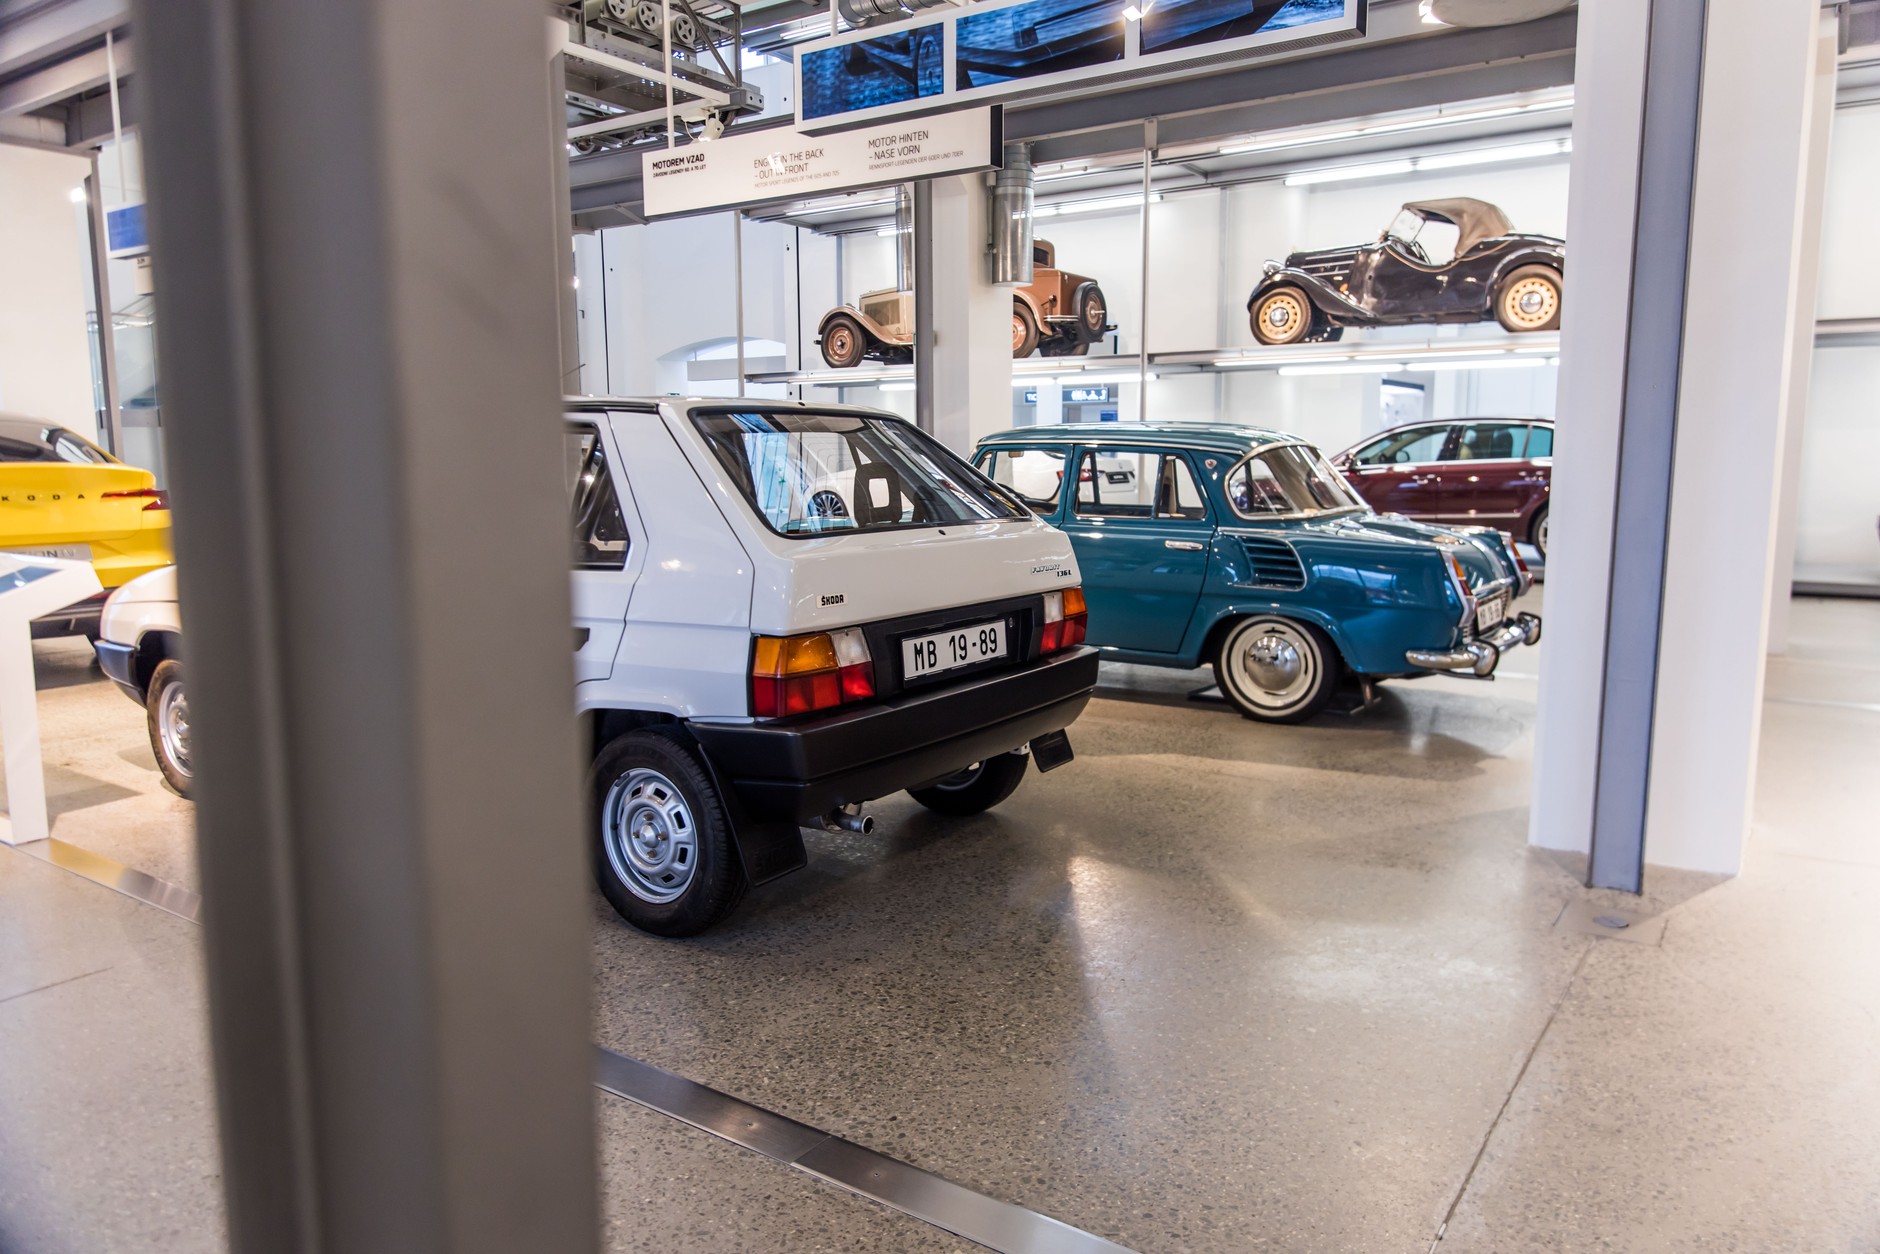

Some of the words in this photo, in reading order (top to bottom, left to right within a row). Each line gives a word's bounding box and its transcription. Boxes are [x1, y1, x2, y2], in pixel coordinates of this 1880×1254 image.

[868, 135, 897, 149] MOTOR
[898, 130, 929, 144] HINTEN
[789, 151, 804, 162] THE
[805, 148, 824, 160] BACK
[874, 148, 895, 160] NASE
[897, 145, 921, 157] VORN
[652, 157, 685, 170] MOTOREM
[685, 153, 705, 164] VZAD
[759, 168, 773, 179] OUT
[784, 162, 809, 175] FRONT
[821, 594, 845, 606] ŠKODA
[913, 640, 937, 671] MB
[949, 627, 998, 662] 19-89
